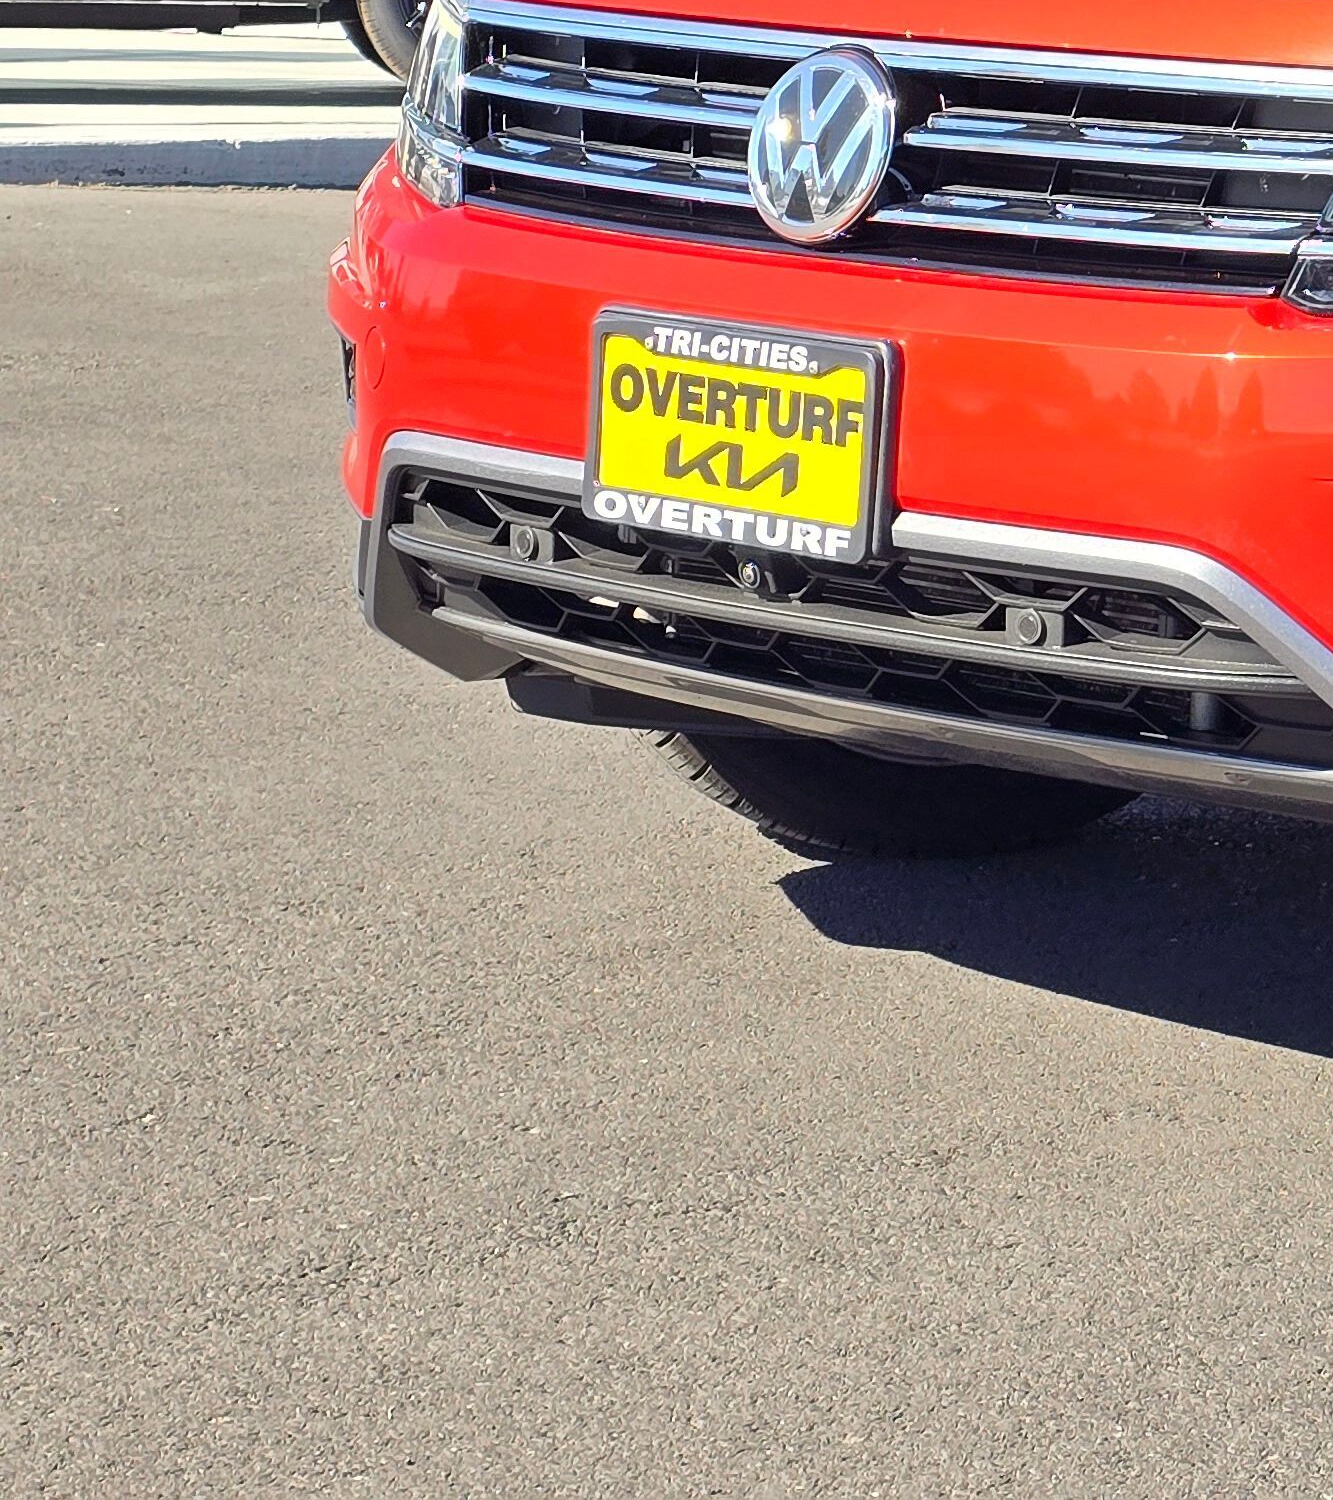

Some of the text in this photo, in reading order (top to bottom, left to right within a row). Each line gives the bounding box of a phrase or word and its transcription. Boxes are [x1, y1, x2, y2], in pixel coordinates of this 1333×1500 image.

[654, 326, 809, 373] TRI-CITIES
[610, 363, 865, 448] OVERTURF
[664, 434, 800, 498] KIA
[593, 491, 852, 557] OVERTURF
